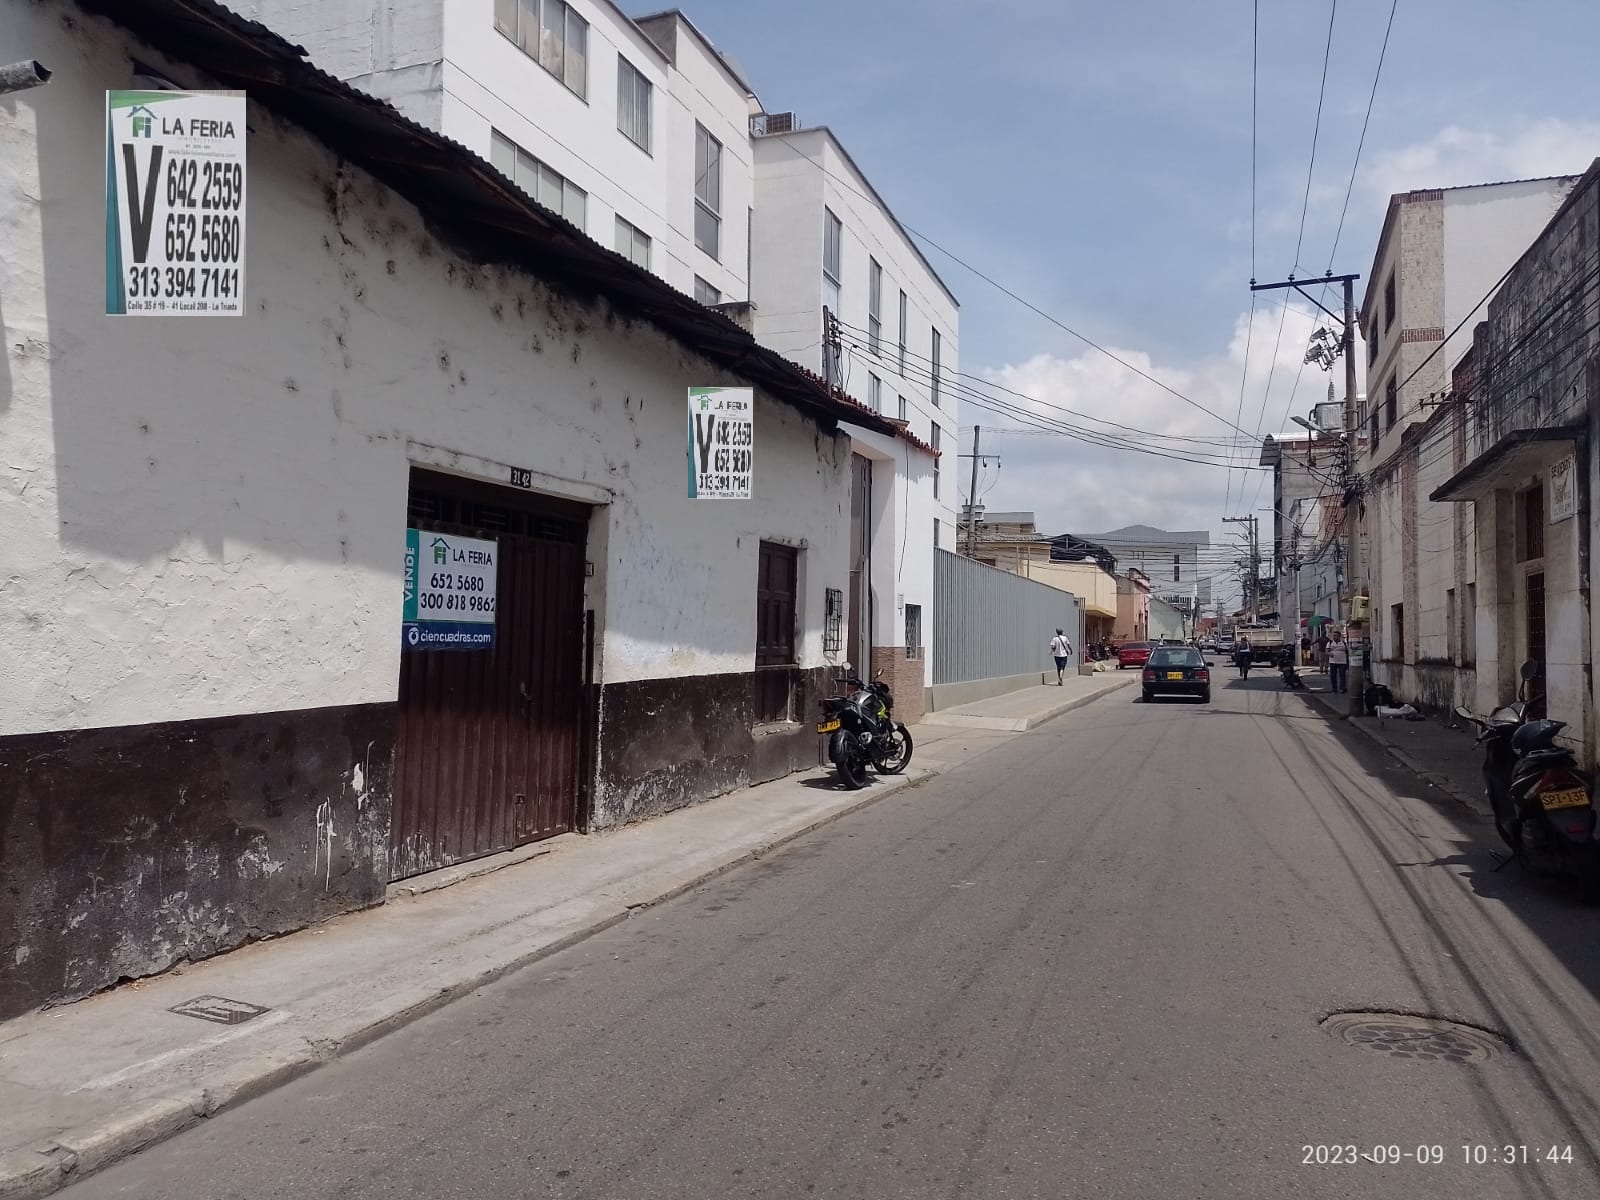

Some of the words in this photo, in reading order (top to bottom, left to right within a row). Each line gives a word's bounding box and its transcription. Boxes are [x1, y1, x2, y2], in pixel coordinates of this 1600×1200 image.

[163, 117, 184, 135] LA
[191, 119, 235, 138] FERIA
[167, 158, 197, 207] 642
[202, 161, 242, 211] 2559
[122, 144, 163, 263] V
[165, 213, 196, 262] 652
[201, 214, 240, 263] 5680
[129, 266, 159, 298] 313
[165, 267, 196, 298] 394
[201, 268, 238, 299] 7141
[453, 549, 466, 563] LA
[468, 550, 493, 566] FERIA
[405, 547, 415, 602] VENDE
[431, 573, 453, 590] 652
[457, 575, 484, 592] 5680
[420, 593, 444, 609] 300
[447, 595, 466, 611] 818
[470, 596, 495, 612] 9862
[420, 629, 491, 643] ciencuadras.com
